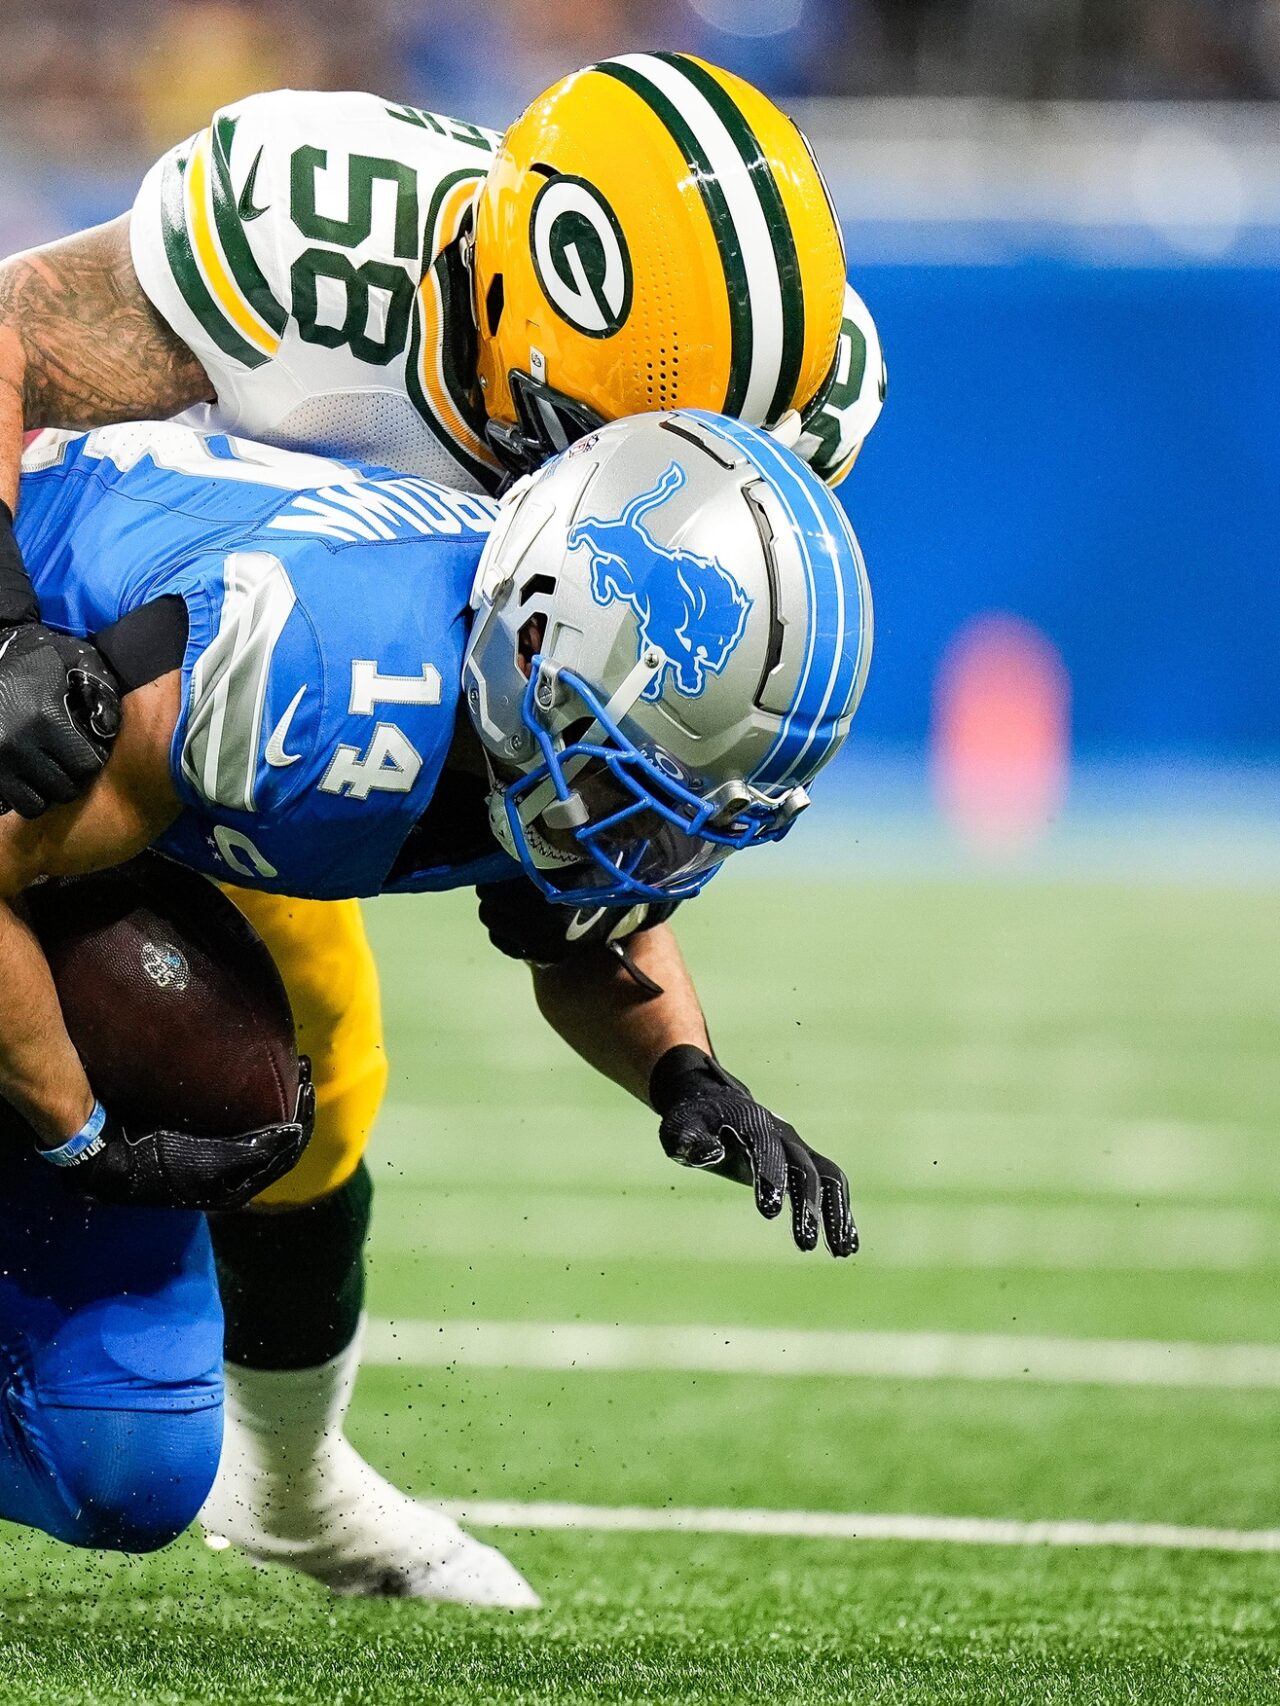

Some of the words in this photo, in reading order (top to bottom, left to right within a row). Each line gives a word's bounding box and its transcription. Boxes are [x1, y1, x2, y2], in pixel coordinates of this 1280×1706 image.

[290, 144, 419, 366] 58
[531, 176, 632, 338] G
[267, 478, 503, 541] ROWN
[317, 660, 442, 800] 14
[86, 1136, 107, 1157] LIFE
